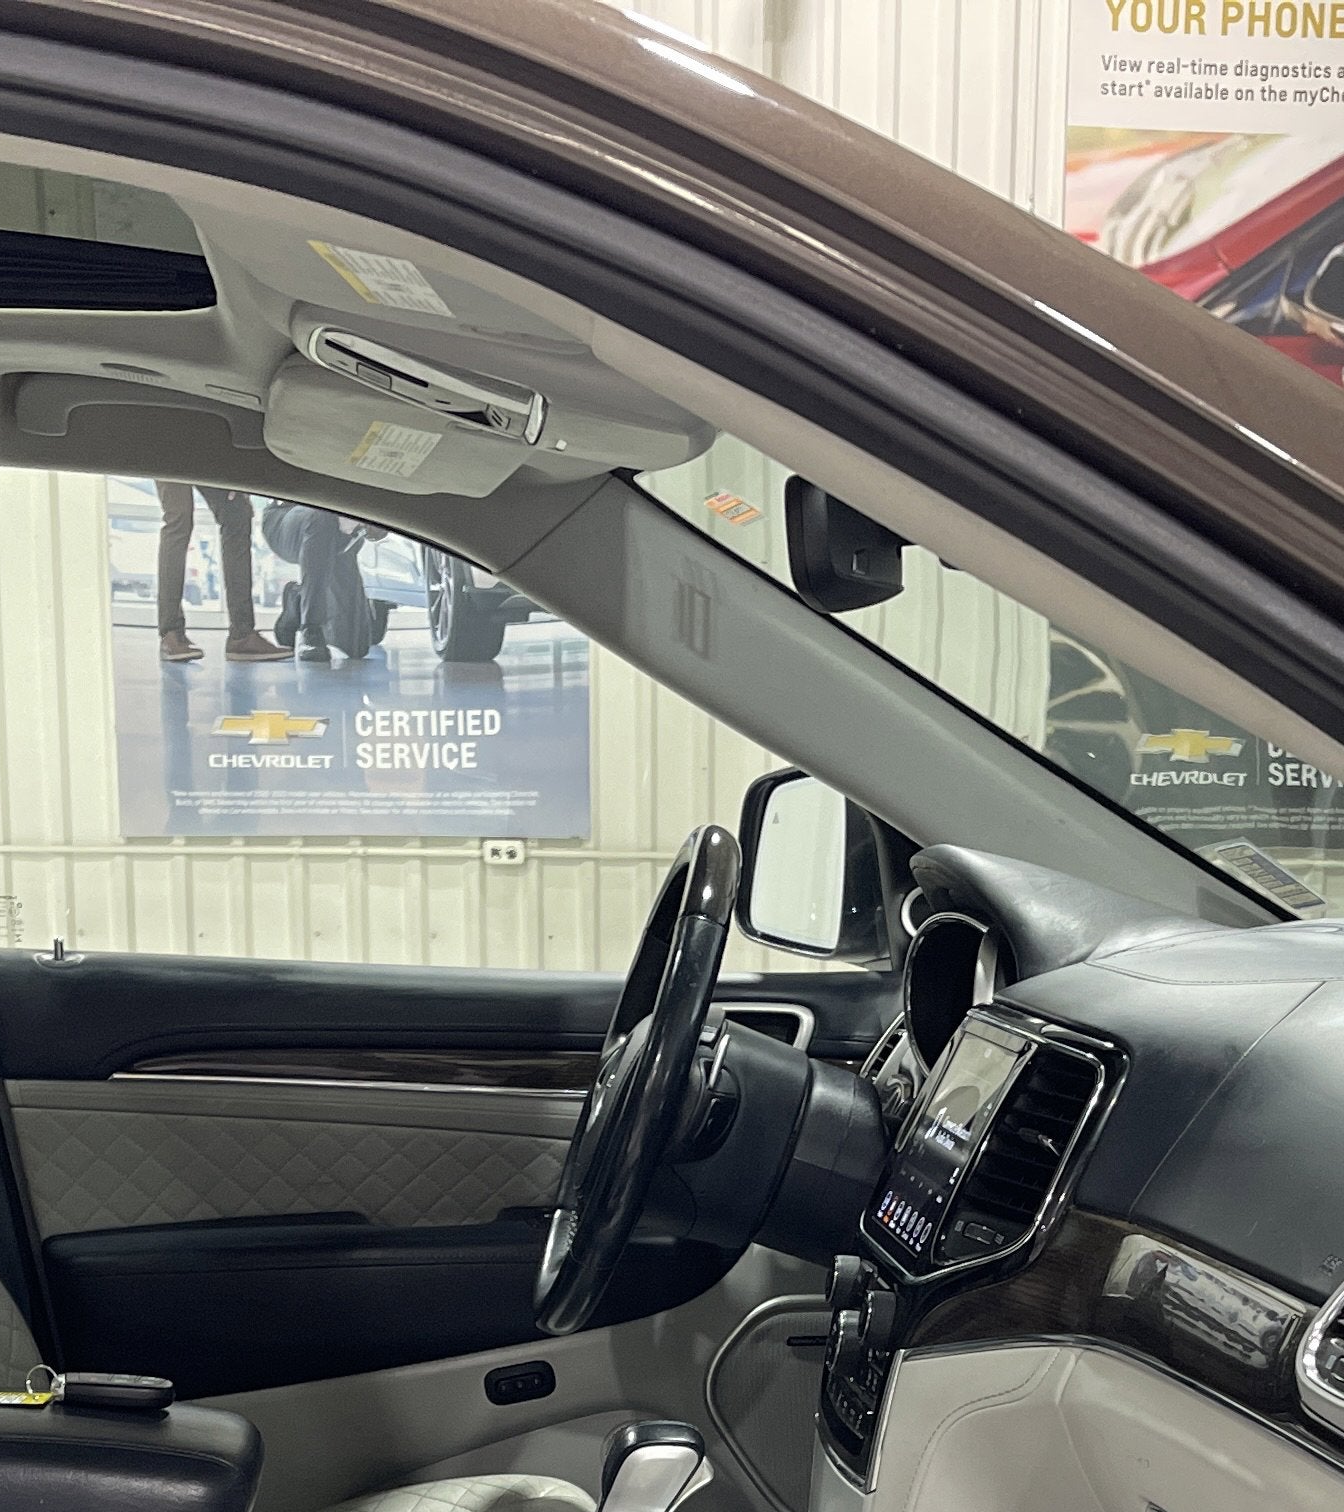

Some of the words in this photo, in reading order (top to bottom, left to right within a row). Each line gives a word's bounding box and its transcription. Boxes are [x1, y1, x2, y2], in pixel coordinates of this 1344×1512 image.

[1107, 0, 1206, 35] YOUR
[1101, 54, 1142, 73] View
[1147, 57, 1228, 76] real-time
[1234, 59, 1331, 82] diagnostics
[1154, 82, 1229, 100] available
[1235, 87, 1254, 101] on
[1260, 85, 1288, 102] the
[355, 709, 501, 737] CERTIFIED
[208, 754, 335, 769] CHEVROLET
[355, 743, 478, 770] SERVICE
[1130, 771, 1248, 787] CHEVROLET
